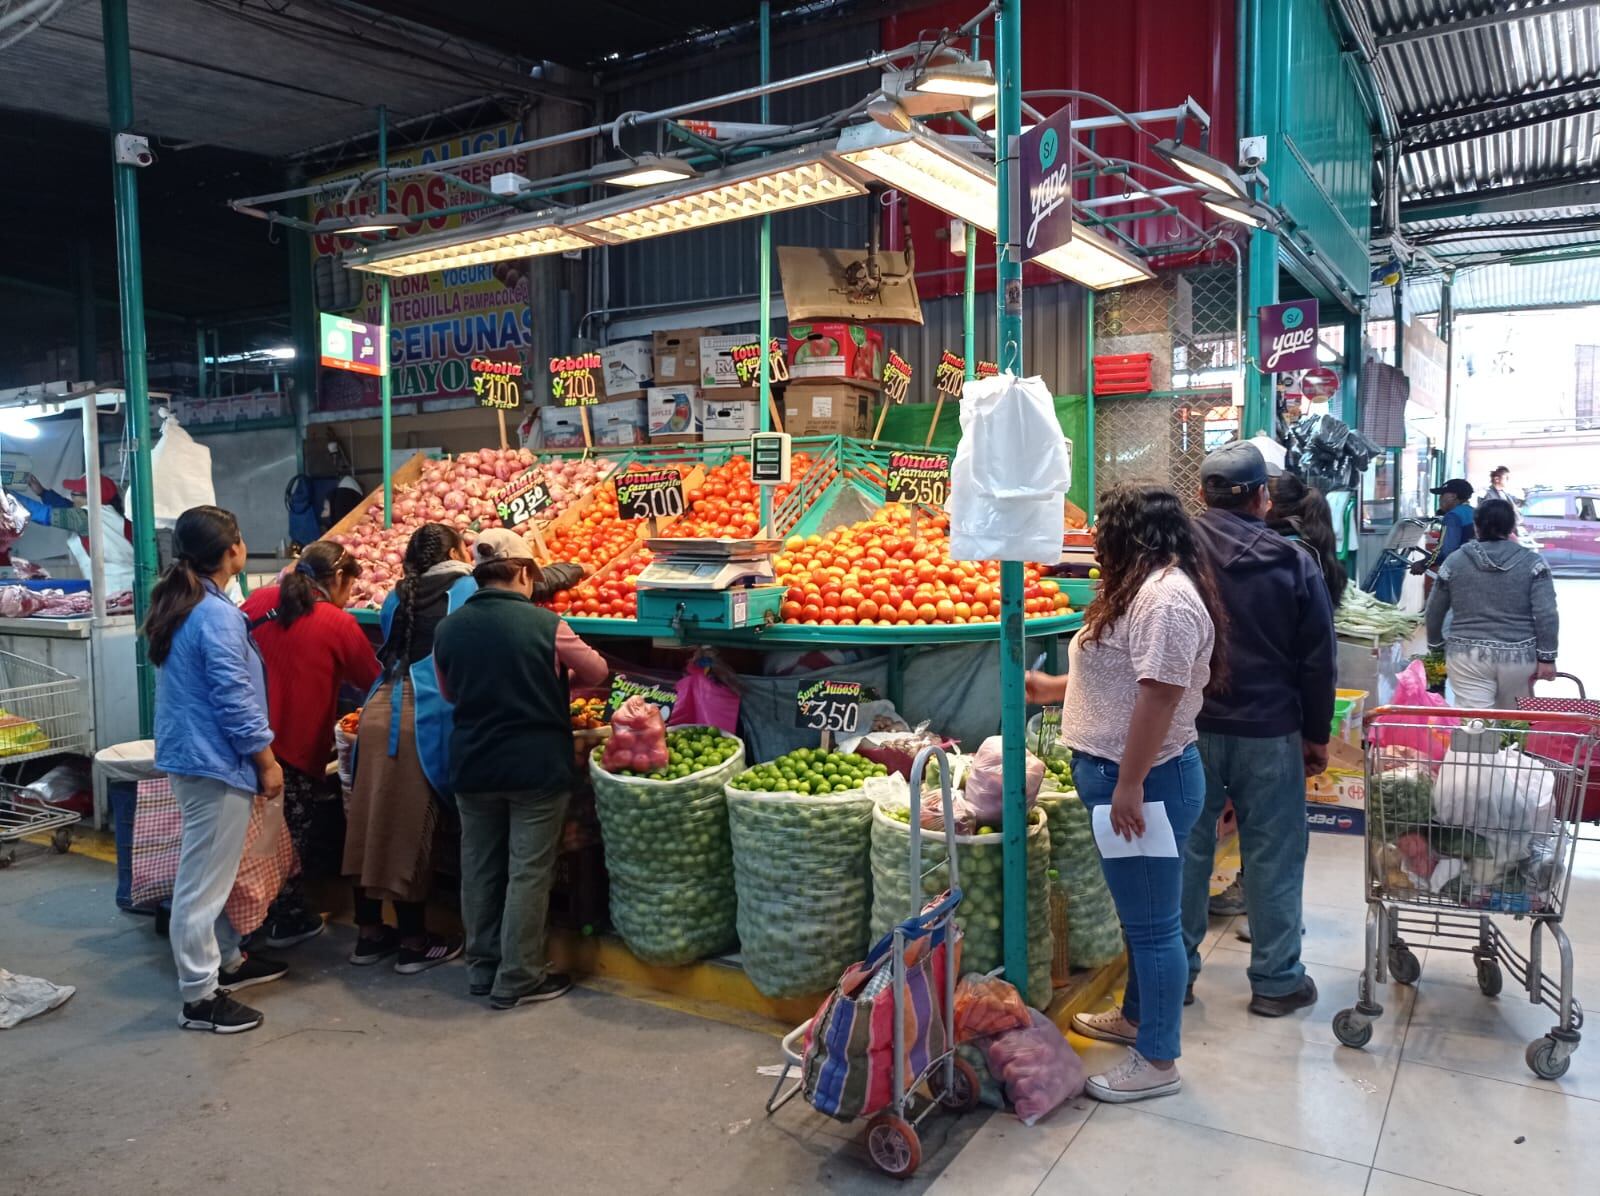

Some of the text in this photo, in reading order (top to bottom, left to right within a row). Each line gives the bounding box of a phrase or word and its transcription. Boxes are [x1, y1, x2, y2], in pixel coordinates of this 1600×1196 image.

[1026, 162, 1067, 249] yape
[366, 274, 430, 302] CHLONA
[367, 291, 461, 324] MTEQUILLA
[390, 310, 533, 363] CEITUNAS
[730, 339, 781, 361] Tome
[1266, 327, 1314, 368] yape
[470, 358, 523, 376] Cebolla
[549, 353, 602, 373] Cebolla
[891, 451, 948, 469] Tomate
[615, 470, 678, 486] Tomate
[631, 486, 684, 519] 3.00
[808, 699, 859, 732] 3.50
